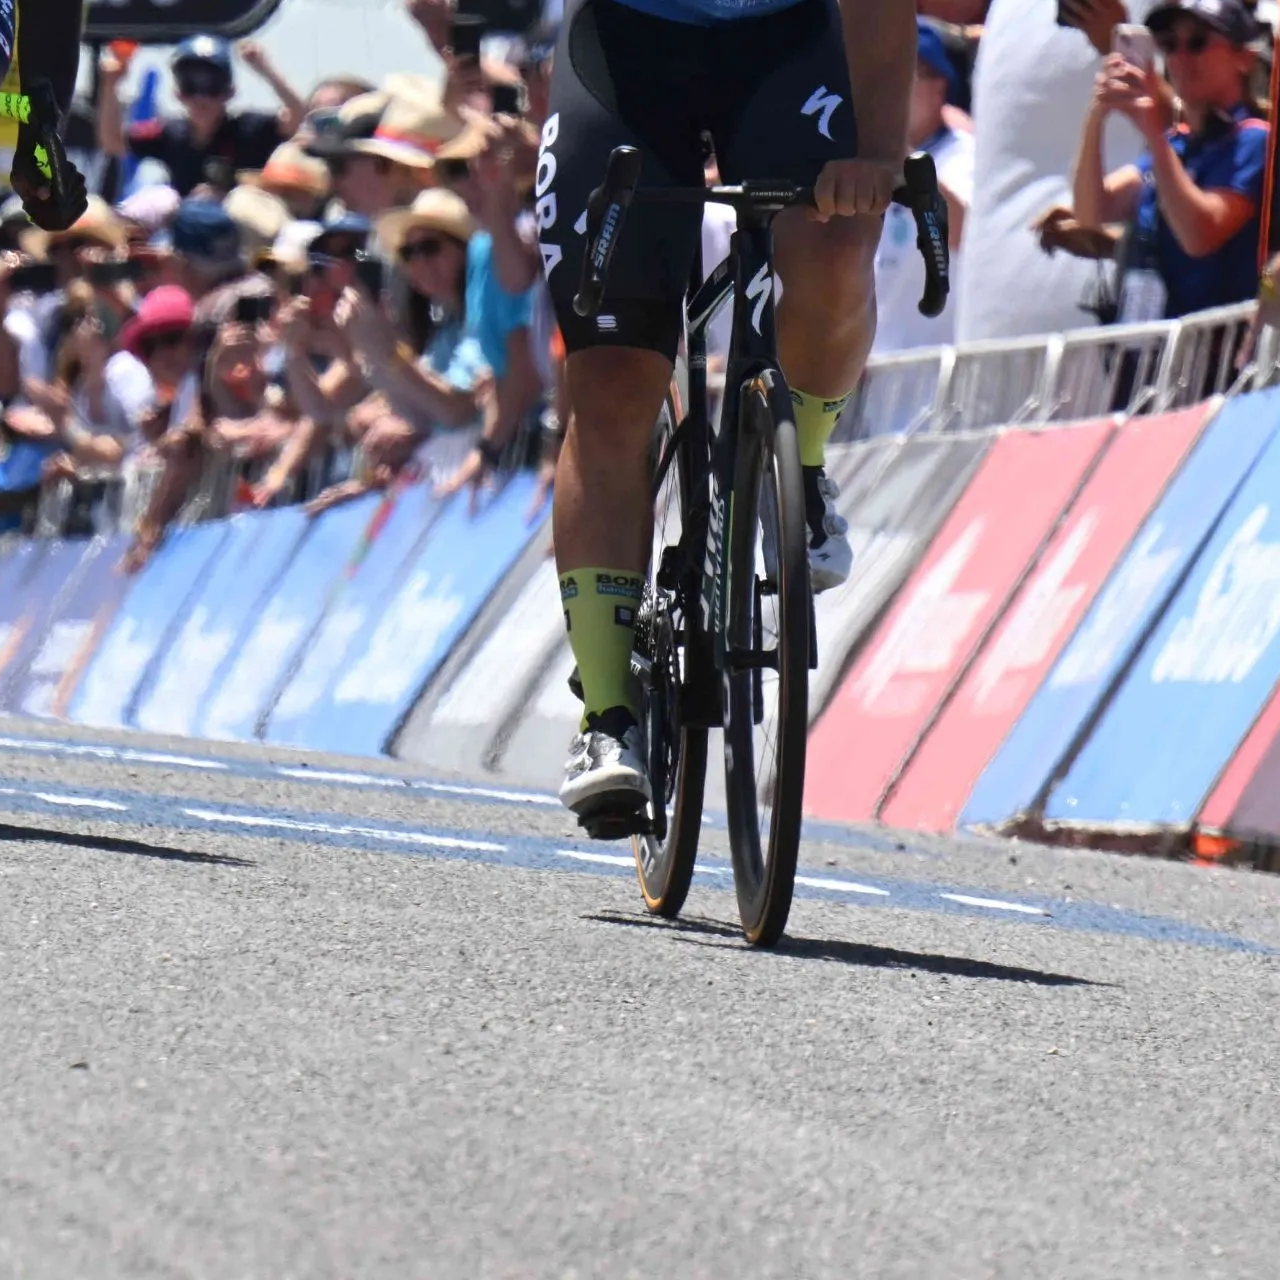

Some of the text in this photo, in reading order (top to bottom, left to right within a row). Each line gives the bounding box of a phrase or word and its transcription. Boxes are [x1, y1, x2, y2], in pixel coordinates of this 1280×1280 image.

[535, 112, 563, 283] BORA
[594, 203, 620, 270] SRAM
[922, 210, 947, 278] SRAM
